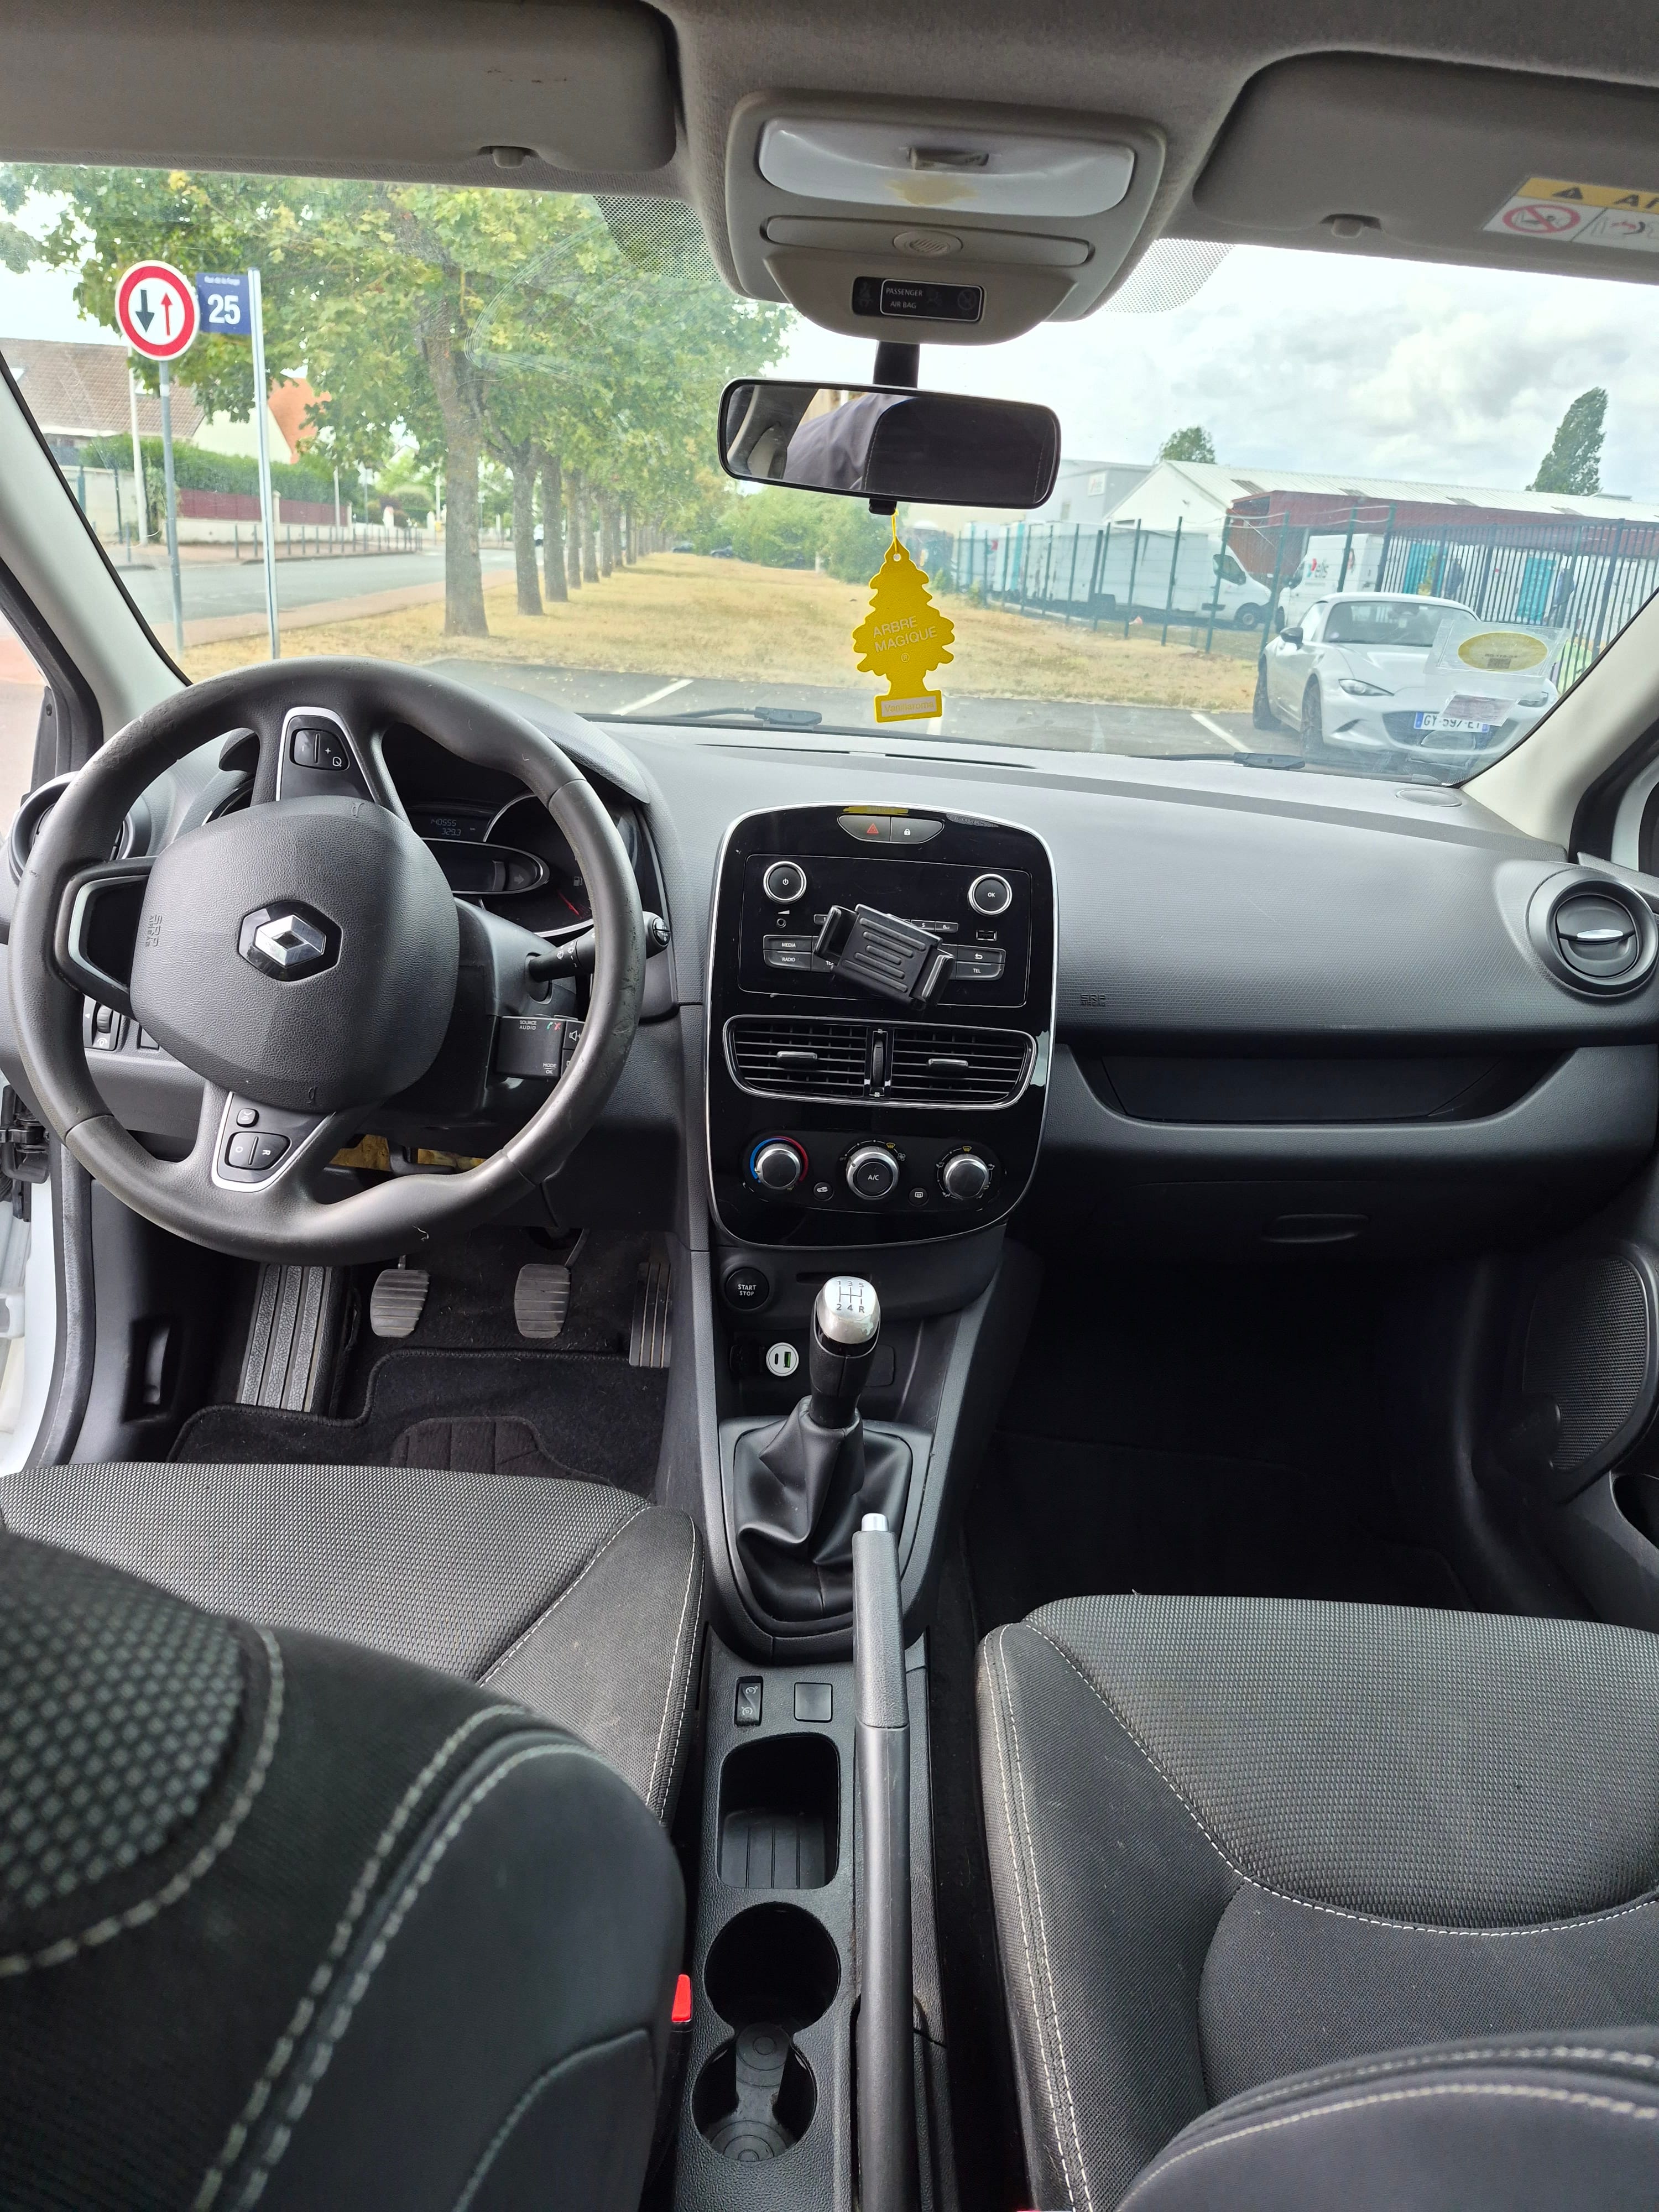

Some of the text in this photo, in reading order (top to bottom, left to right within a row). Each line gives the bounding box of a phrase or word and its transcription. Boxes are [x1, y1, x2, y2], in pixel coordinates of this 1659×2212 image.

[886, 288, 923, 296] PASSENGER
[207, 294, 241, 325] 25
[874, 616, 918, 638] ARBRE
[875, 627, 938, 653] MAGIQUE
[859, 1305, 865, 1313] R
